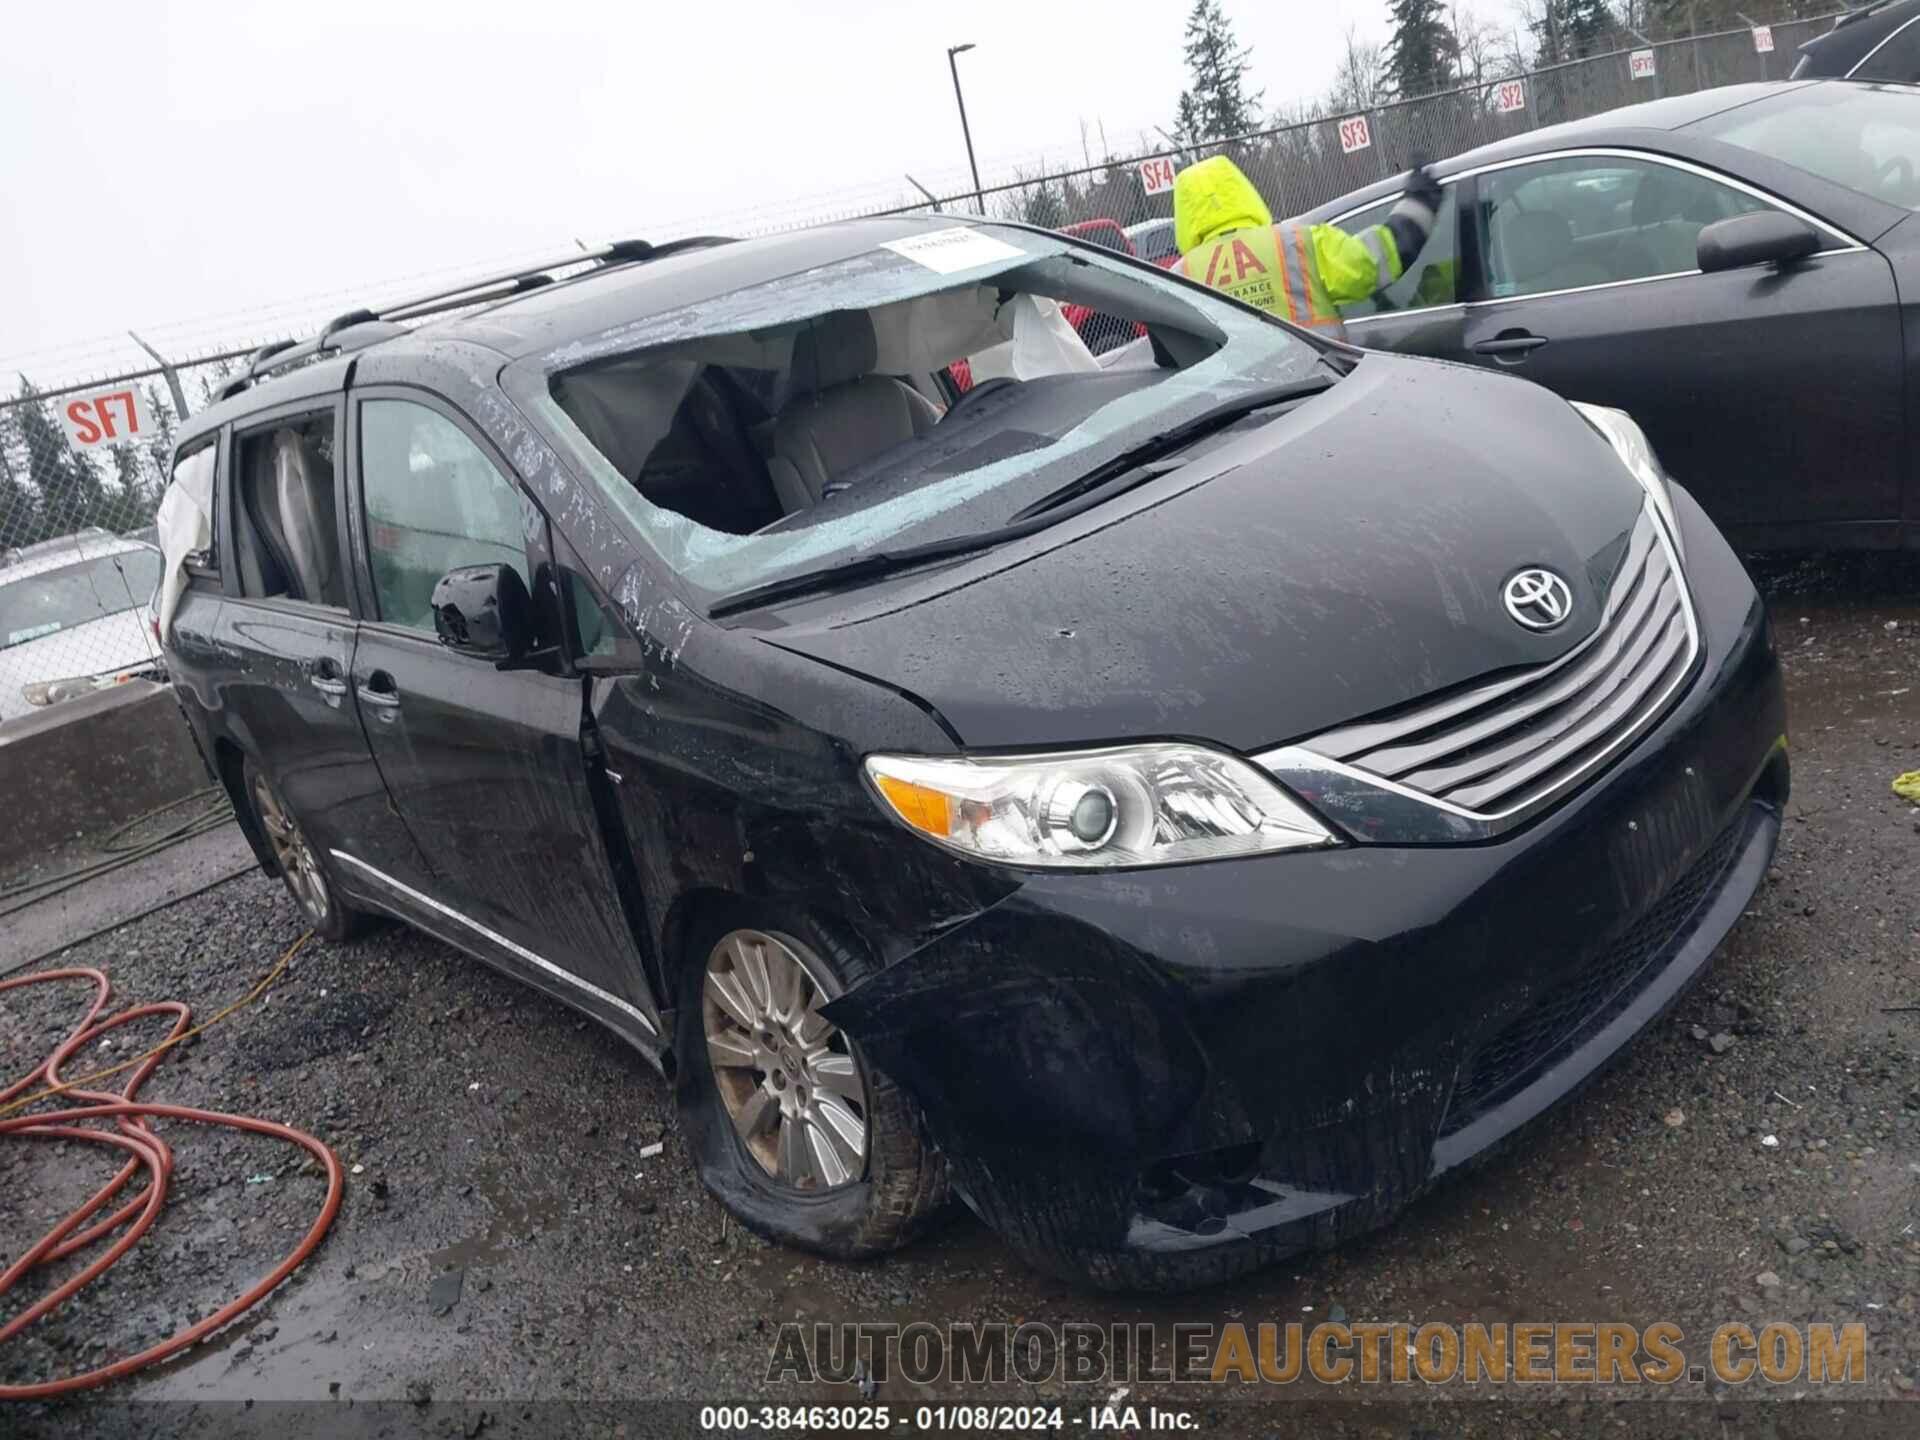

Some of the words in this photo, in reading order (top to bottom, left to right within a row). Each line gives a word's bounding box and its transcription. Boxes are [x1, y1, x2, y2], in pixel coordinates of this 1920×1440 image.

[1502, 84, 1522, 109] SF2
[1342, 120, 1367, 148] SF3
[1143, 159, 1173, 190] SF4
[67, 391, 139, 443] SF7
